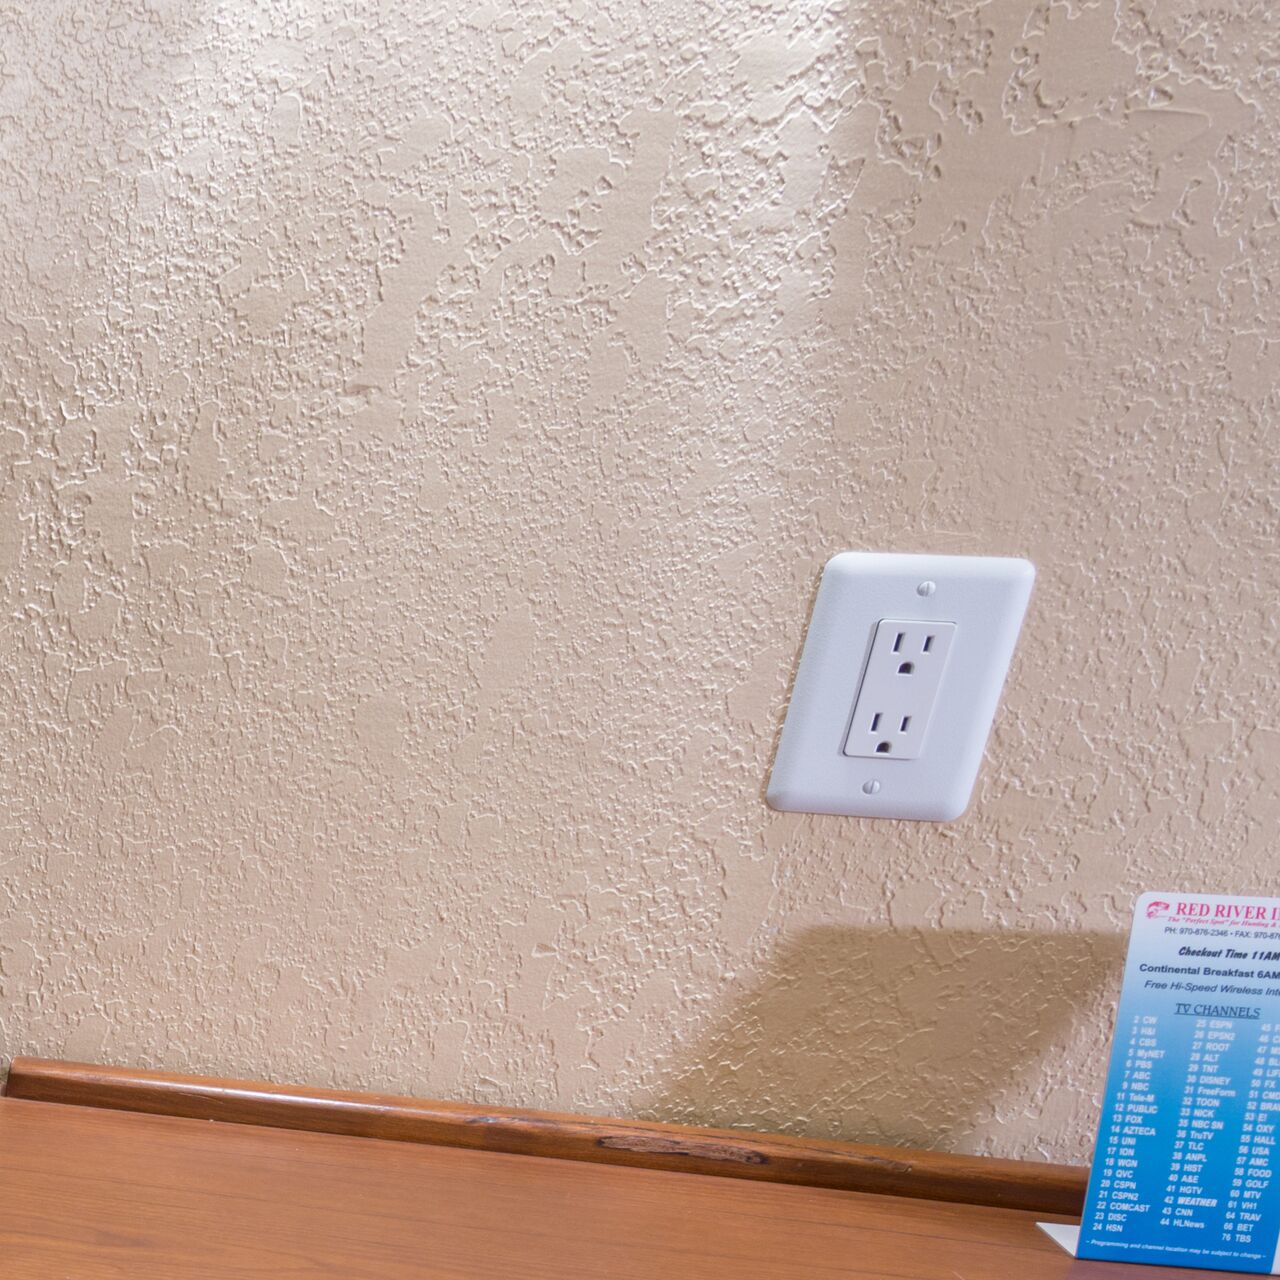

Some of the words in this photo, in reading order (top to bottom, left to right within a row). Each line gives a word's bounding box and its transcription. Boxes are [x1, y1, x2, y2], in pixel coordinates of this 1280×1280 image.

[1176, 903, 1210, 917] RED
[1215, 905, 1267, 920] RIVER
[1179, 947, 1222, 958] Checkout
[1224, 949, 1248, 959] Time
[1139, 964, 1200, 974] Continental
[1203, 967, 1254, 978] Breakfast
[1144, 980, 1168, 989] Free
[1170, 982, 1217, 993] Hi-Speed
[1220, 984, 1263, 995] Wireless
[1176, 1003, 1191, 1014] TV
[1193, 1004, 1261, 1018] CHANNELS
[1131, 1082, 1149, 1090] NBC
[1196, 1098, 1220, 1106] TOON
[1127, 1104, 1158, 1113] PUBLIC
[1194, 1109, 1215, 1117] NICK
[1125, 1115, 1143, 1123] FOX
[1192, 1120, 1209, 1128] NBC
[1211, 1121, 1223, 1129] SN
[1123, 1127, 1156, 1136] AZTECA
[1256, 1125, 1274, 1133] OXY
[1190, 1131, 1214, 1140] TruTV
[1254, 1136, 1276, 1144] HALL
[1188, 1142, 1204, 1150] TLC
[1119, 1148, 1134, 1156] ION
[1252, 1147, 1270, 1155] USA
[1185, 1153, 1207, 1162] ANPL
[1118, 1159, 1138, 1167] WGN
[1249, 1158, 1269, 1166] AMC
[1184, 1164, 1203, 1172] HIST
[1116, 1170, 1133, 1178] QVC
[1248, 1169, 1272, 1177] FOOD
[1114, 1180, 1136, 1189] CSPN
[1246, 1180, 1269, 1188] GOLF
[1180, 1186, 1203, 1194] HGTV
[1112, 1192, 1139, 1200] CSPN2
[1244, 1191, 1261, 1199] MTV
[1177, 1197, 1217, 1207] WEATHER
[1110, 1202, 1150, 1212] COMCAST
[1175, 1208, 1193, 1216] CNN
[1108, 1213, 1127, 1221] DISC
[1240, 1213, 1261, 1221] TRAV
[1174, 1219, 1204, 1228] HLNews
[1106, 1224, 1123, 1232] HSN
